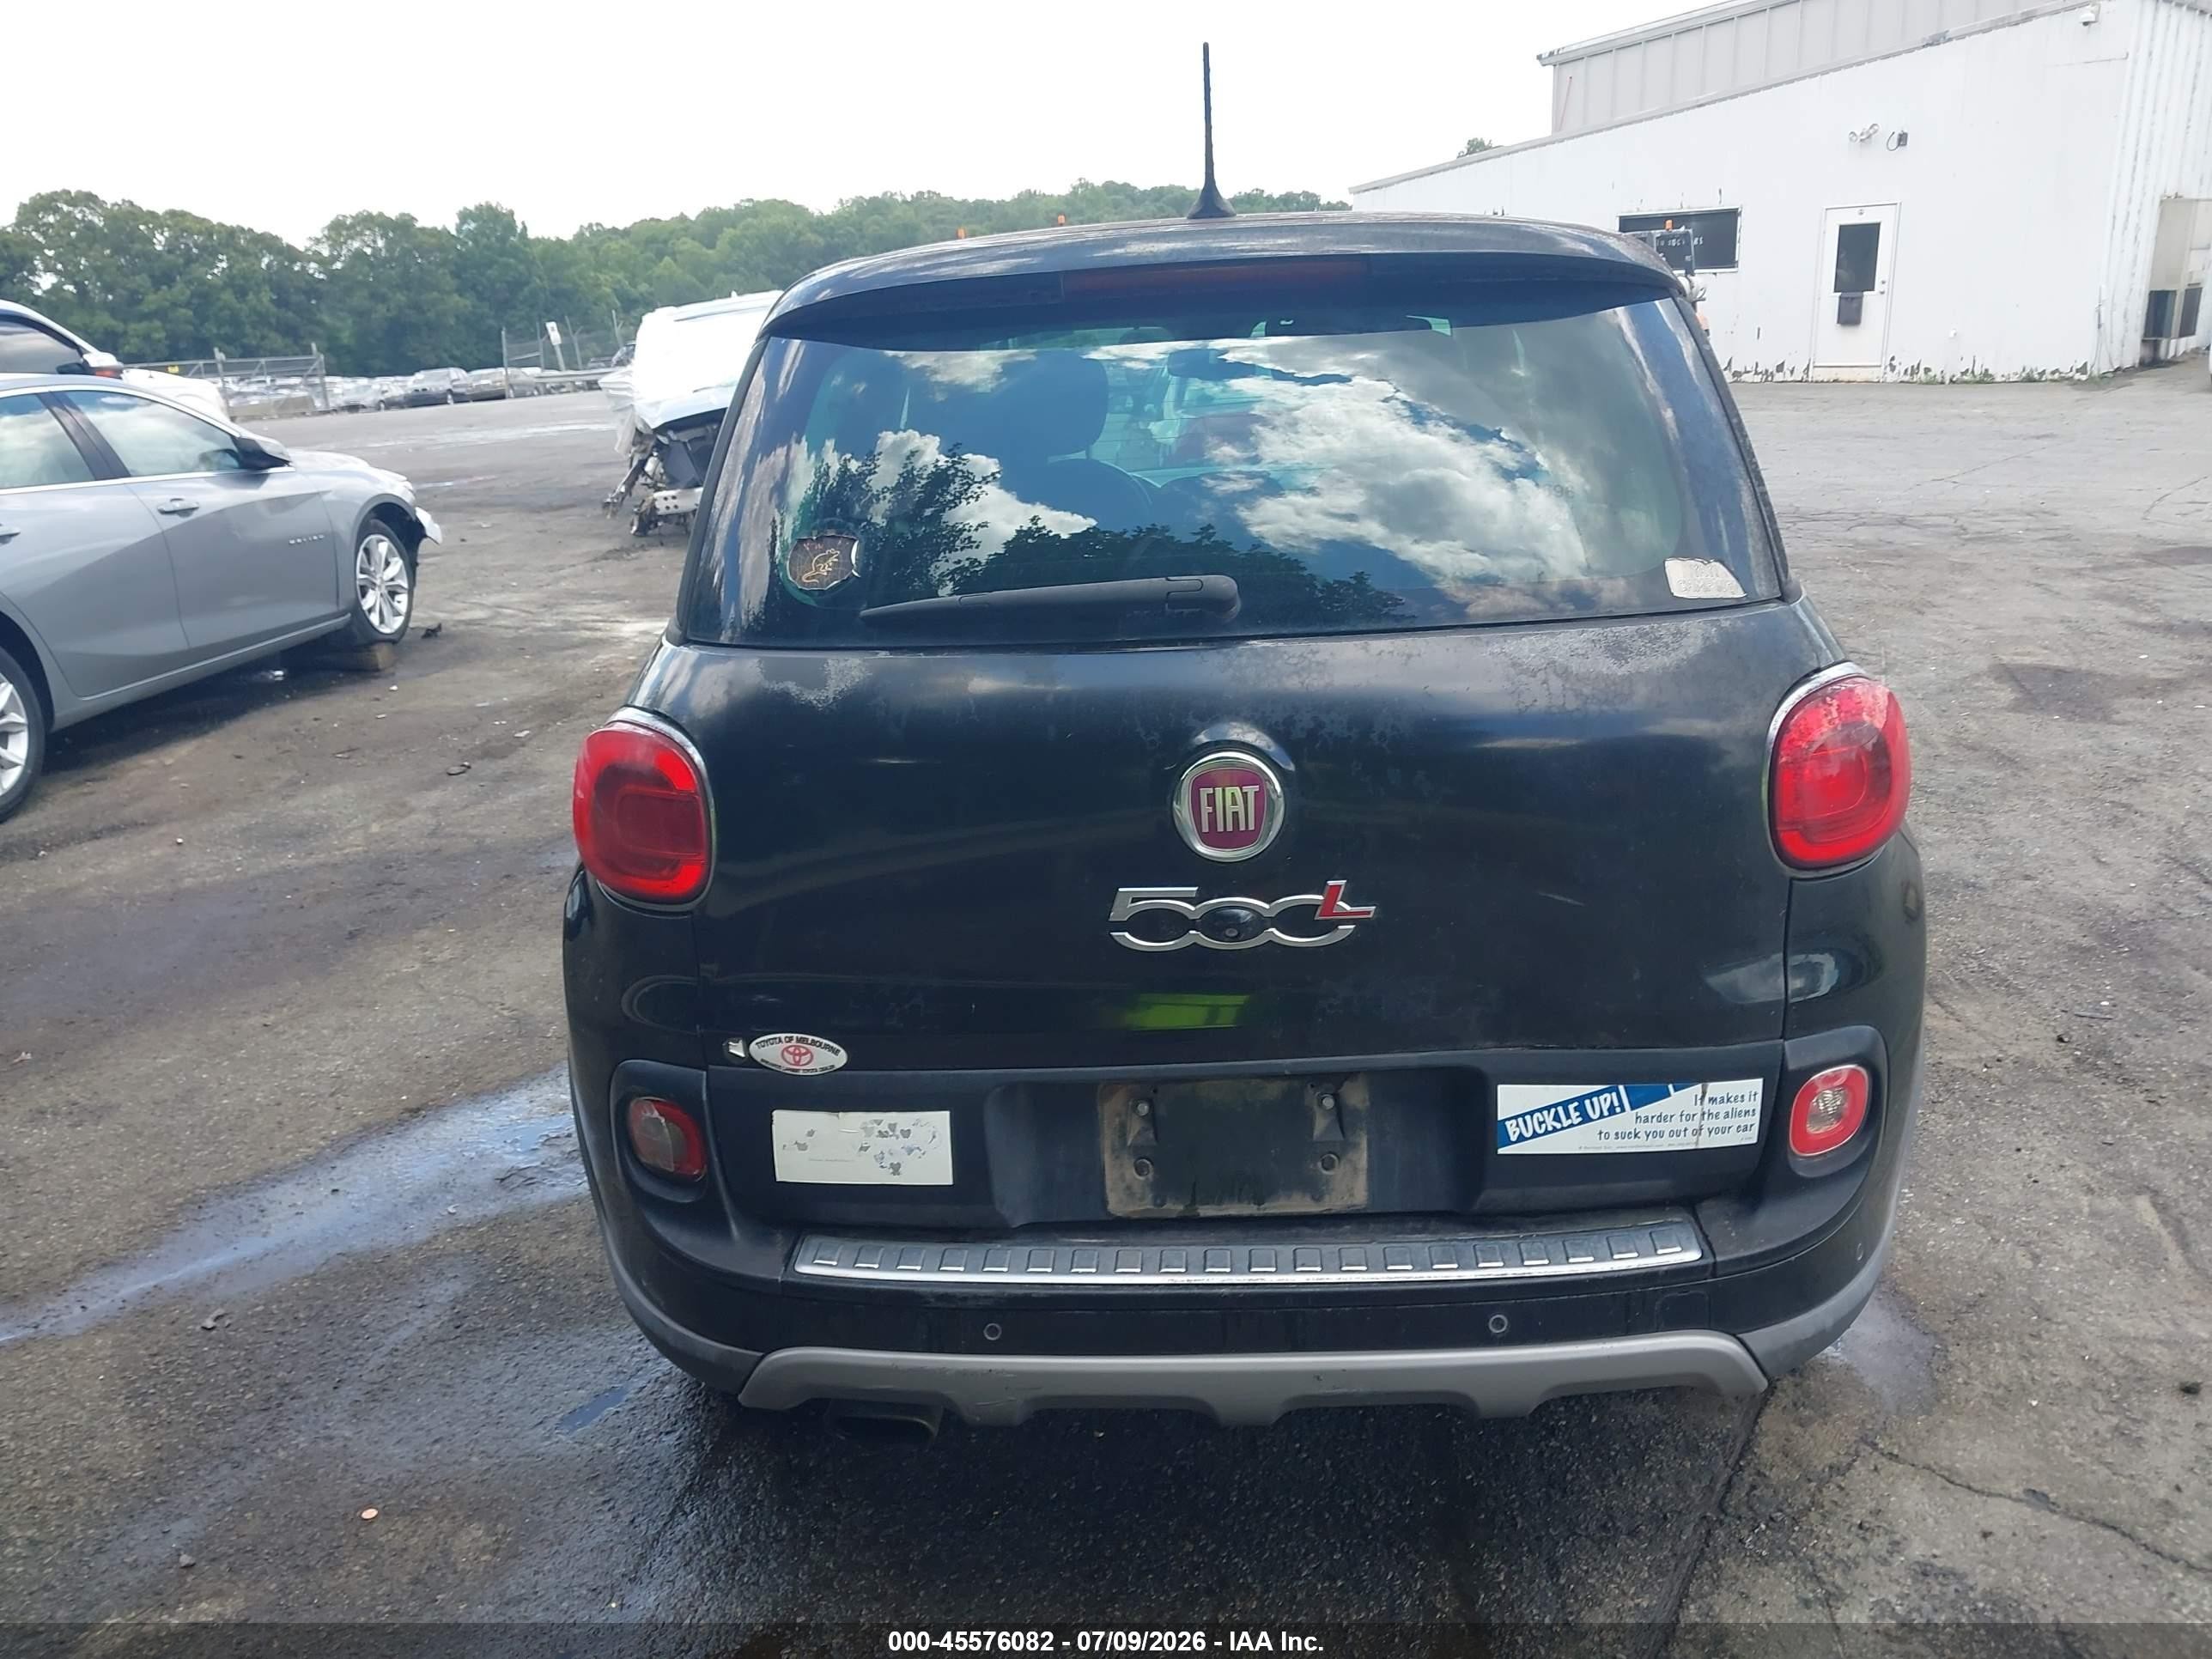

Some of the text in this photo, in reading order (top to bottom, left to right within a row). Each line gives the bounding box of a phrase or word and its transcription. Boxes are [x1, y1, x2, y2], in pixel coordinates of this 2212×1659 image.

[1199, 785, 1260, 833] FIAT
[1108, 880, 1376, 952] 500L
[756, 1036, 783, 1048] TOYOTA
[795, 1036, 842, 1056] MELBOURNE
[1708, 1092, 1745, 1105] makes
[1748, 1091, 1759, 1103] it
[1504, 1091, 1621, 1142] BUCKLE UP!
[1635, 1106, 1757, 1124] harder for the aliens
[1597, 1121, 1756, 1141] to suck you out of your car
